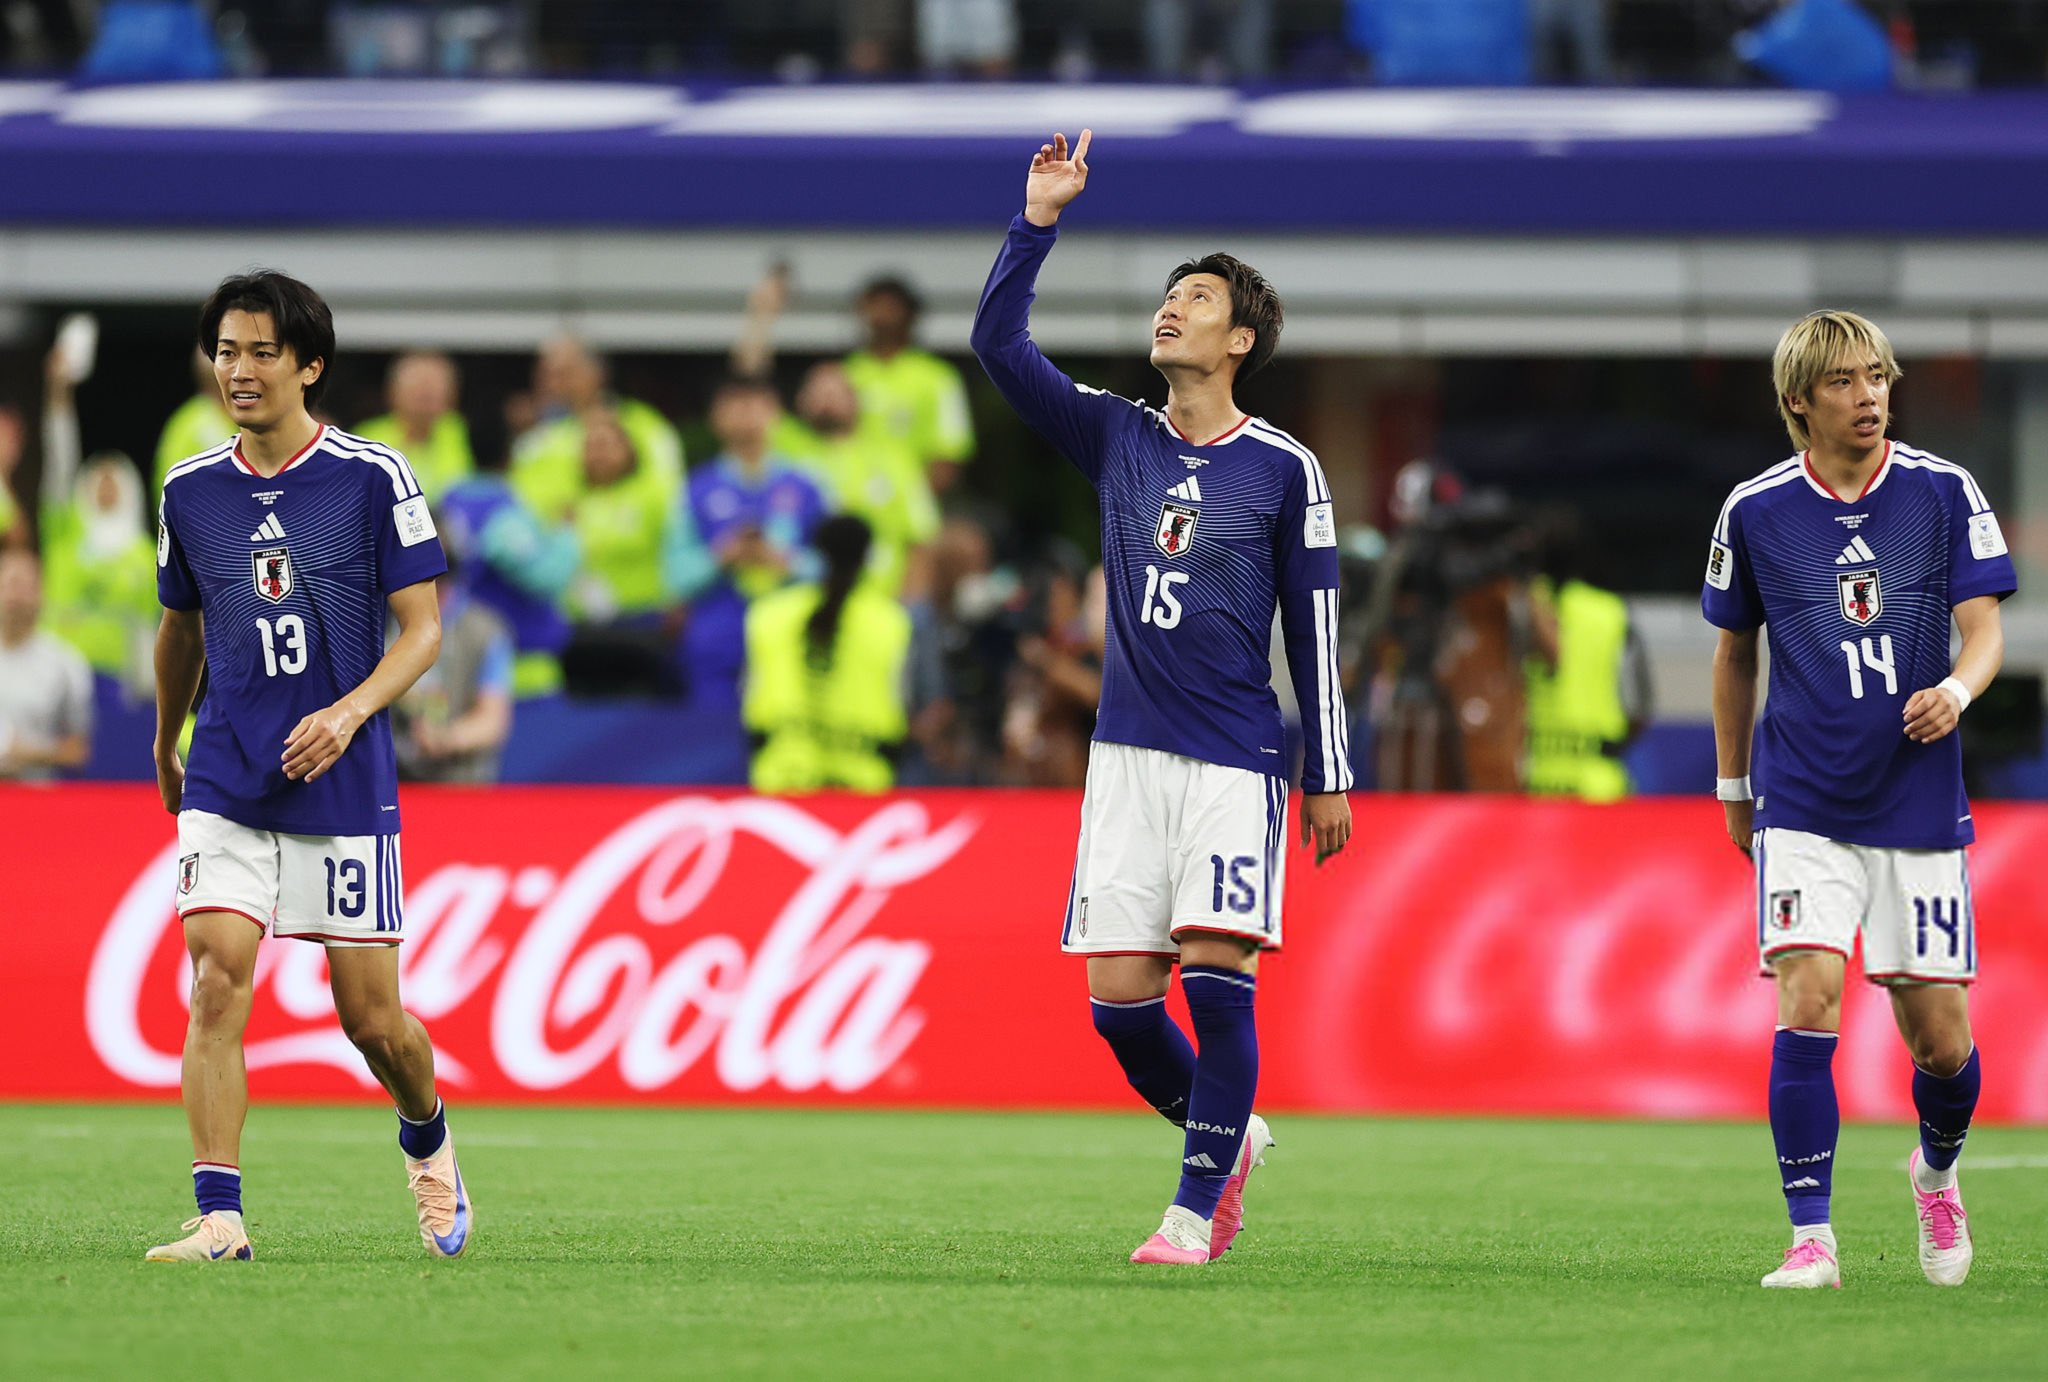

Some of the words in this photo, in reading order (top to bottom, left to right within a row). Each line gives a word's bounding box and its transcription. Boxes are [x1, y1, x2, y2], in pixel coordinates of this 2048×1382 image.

[1171, 506, 1192, 515] JAPAN
[1141, 564, 1190, 630] 15
[1847, 573, 1870, 581] JAPAN
[255, 614, 308, 677] 13
[1840, 634, 1898, 699] 14
[324, 856, 366, 918] 13
[1210, 854, 1258, 913] 15
[1913, 896, 1959, 958] 14
